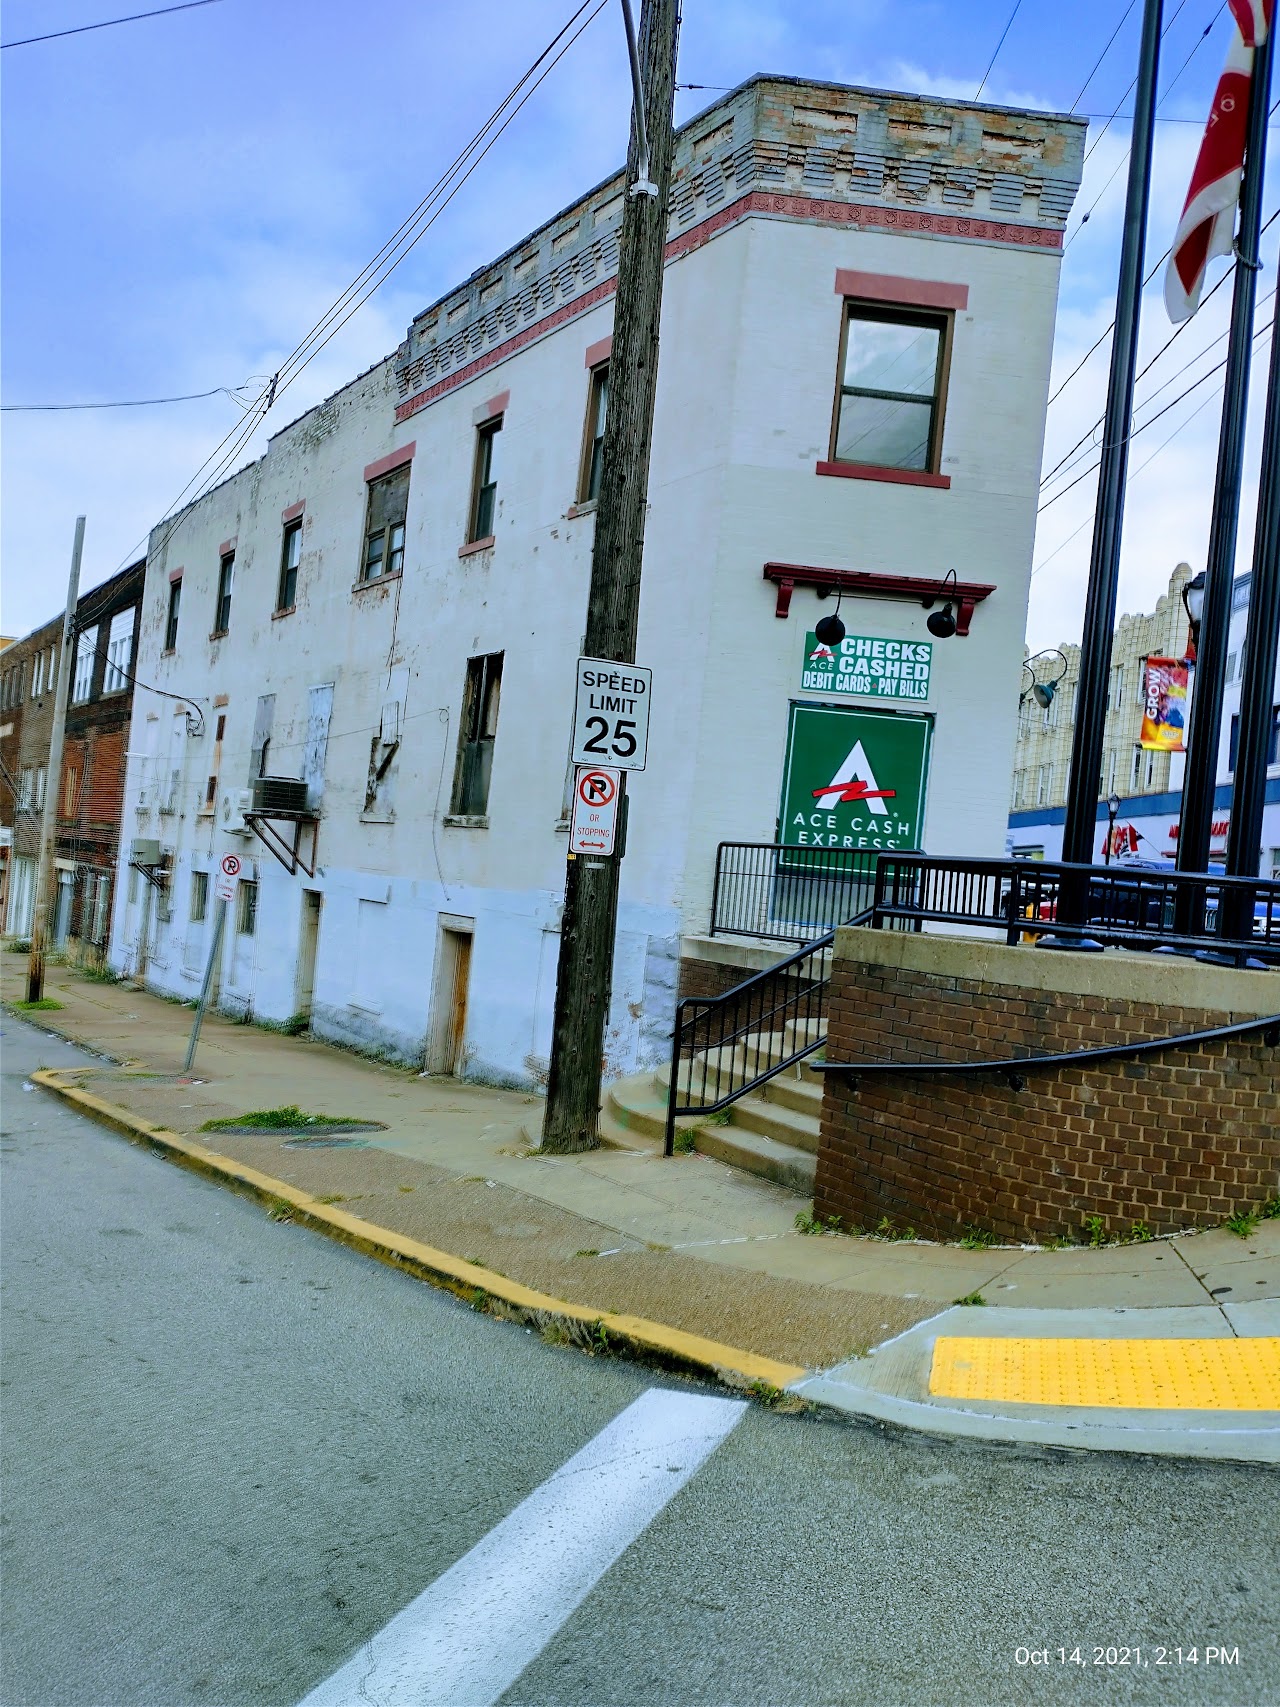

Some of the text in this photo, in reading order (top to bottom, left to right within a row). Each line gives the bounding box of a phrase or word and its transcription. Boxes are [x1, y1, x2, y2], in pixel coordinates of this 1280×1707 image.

[840, 638, 931, 662] CHECKS
[809, 661, 834, 671] ACE
[839, 656, 930, 681] CASHED
[583, 670, 646, 695] SPEED
[803, 670, 928, 699] DEBIT CARDS PAY BILLS
[1146, 668, 1161, 720] GROW
[589, 693, 637, 715] LIMIT
[583, 716, 637, 758] 25
[589, 813, 600, 823] OR
[793, 812, 909, 836] ACE CASH
[577, 827, 610, 838] STOPPING
[798, 831, 897, 850] EXPRESS
